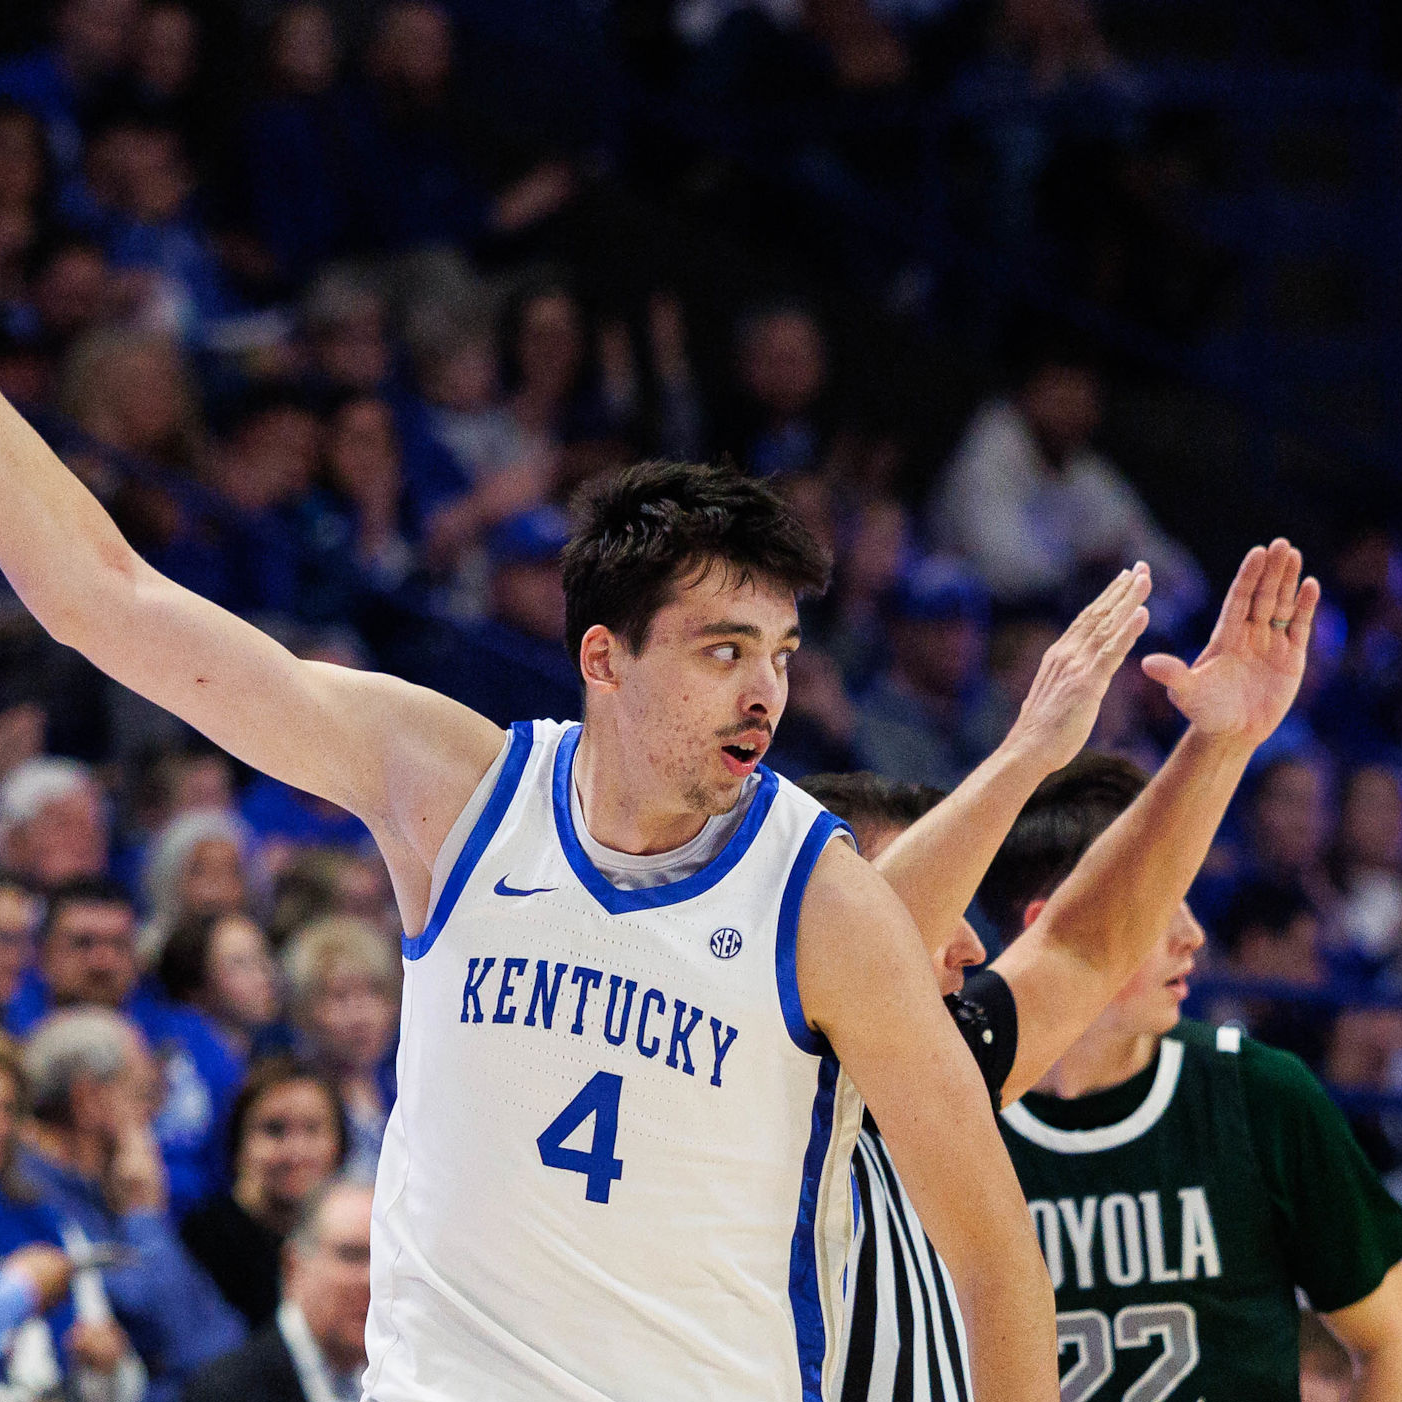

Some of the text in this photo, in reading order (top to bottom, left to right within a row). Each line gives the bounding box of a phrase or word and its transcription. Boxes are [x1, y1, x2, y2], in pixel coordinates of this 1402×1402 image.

[710, 928, 742, 958] SEC
[460, 957, 738, 1088] KENTUCKY
[536, 1070, 623, 1204] 4
